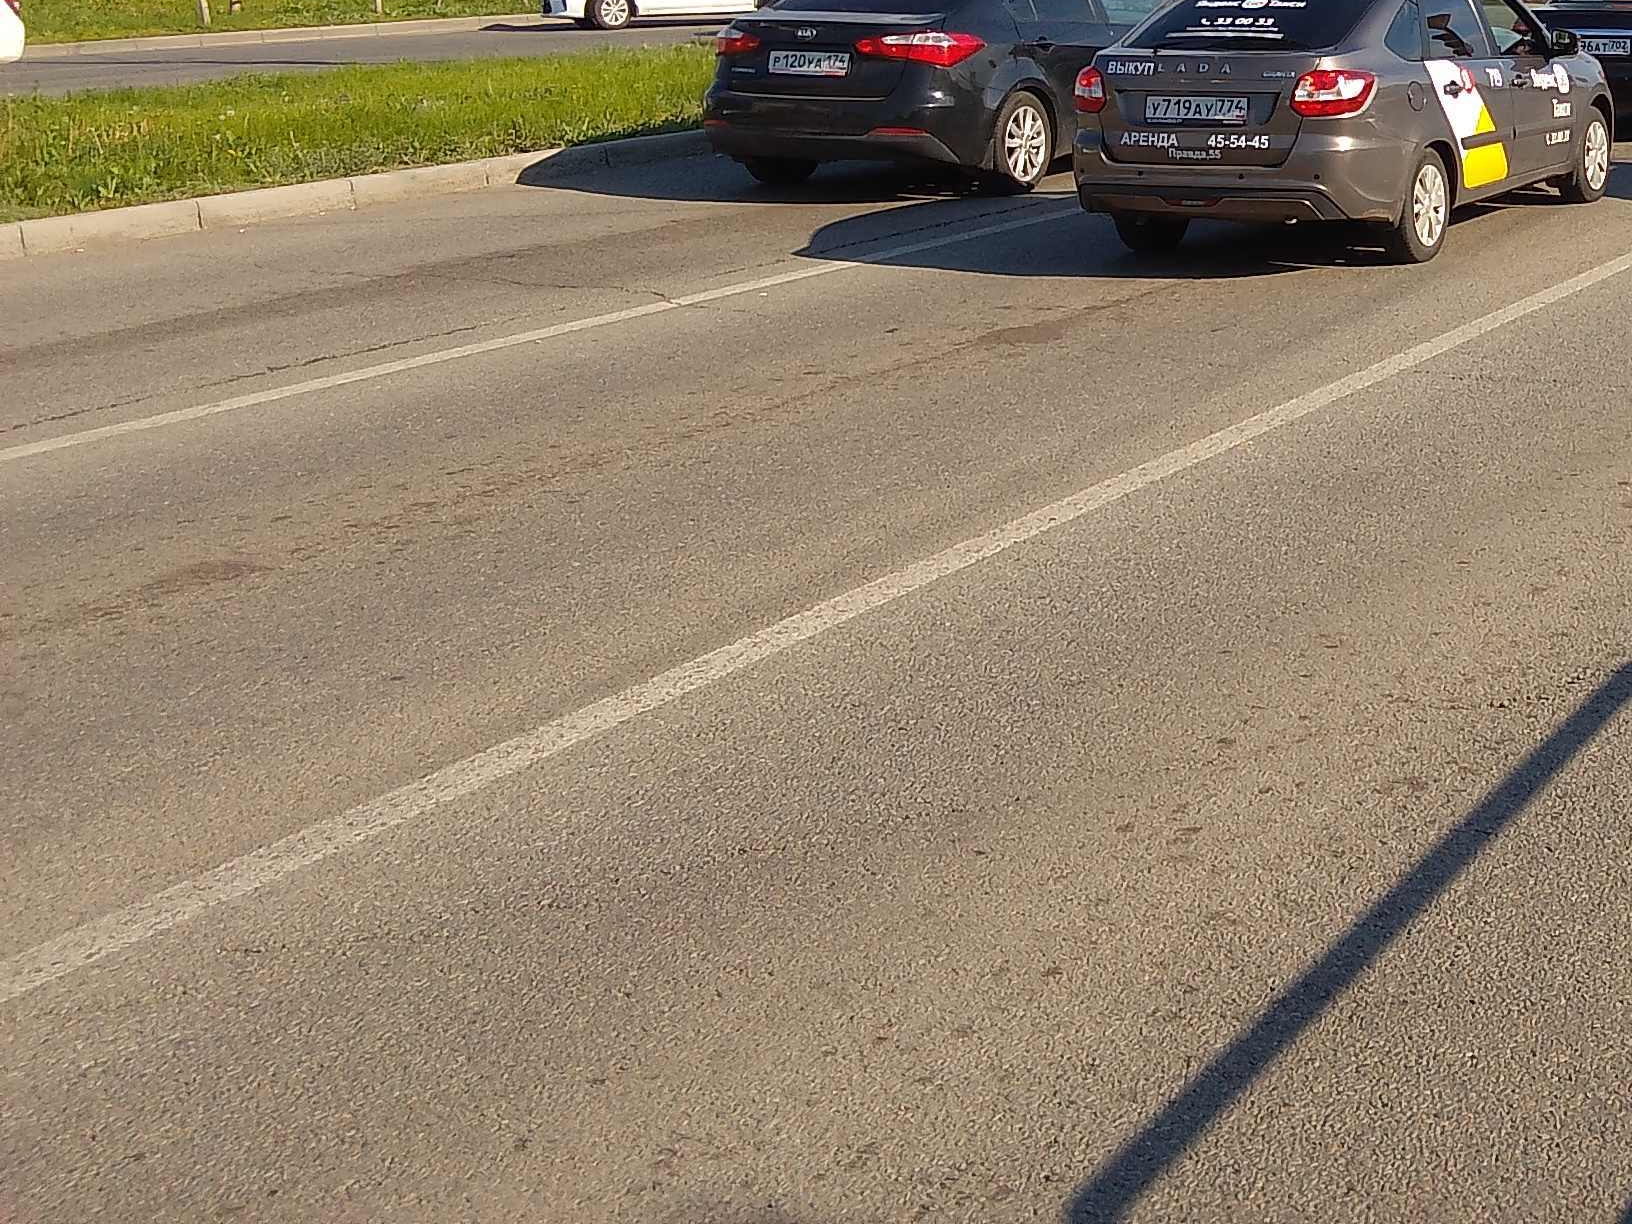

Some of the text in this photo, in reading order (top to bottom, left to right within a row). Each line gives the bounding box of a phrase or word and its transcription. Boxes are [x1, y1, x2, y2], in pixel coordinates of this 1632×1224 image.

[1107, 61, 1155, 76] ВЫКУП
[1157, 63, 1232, 74] LADA
[1120, 131, 1179, 147] АРЕНДА
[1207, 133, 1270, 150] 45-54-45
